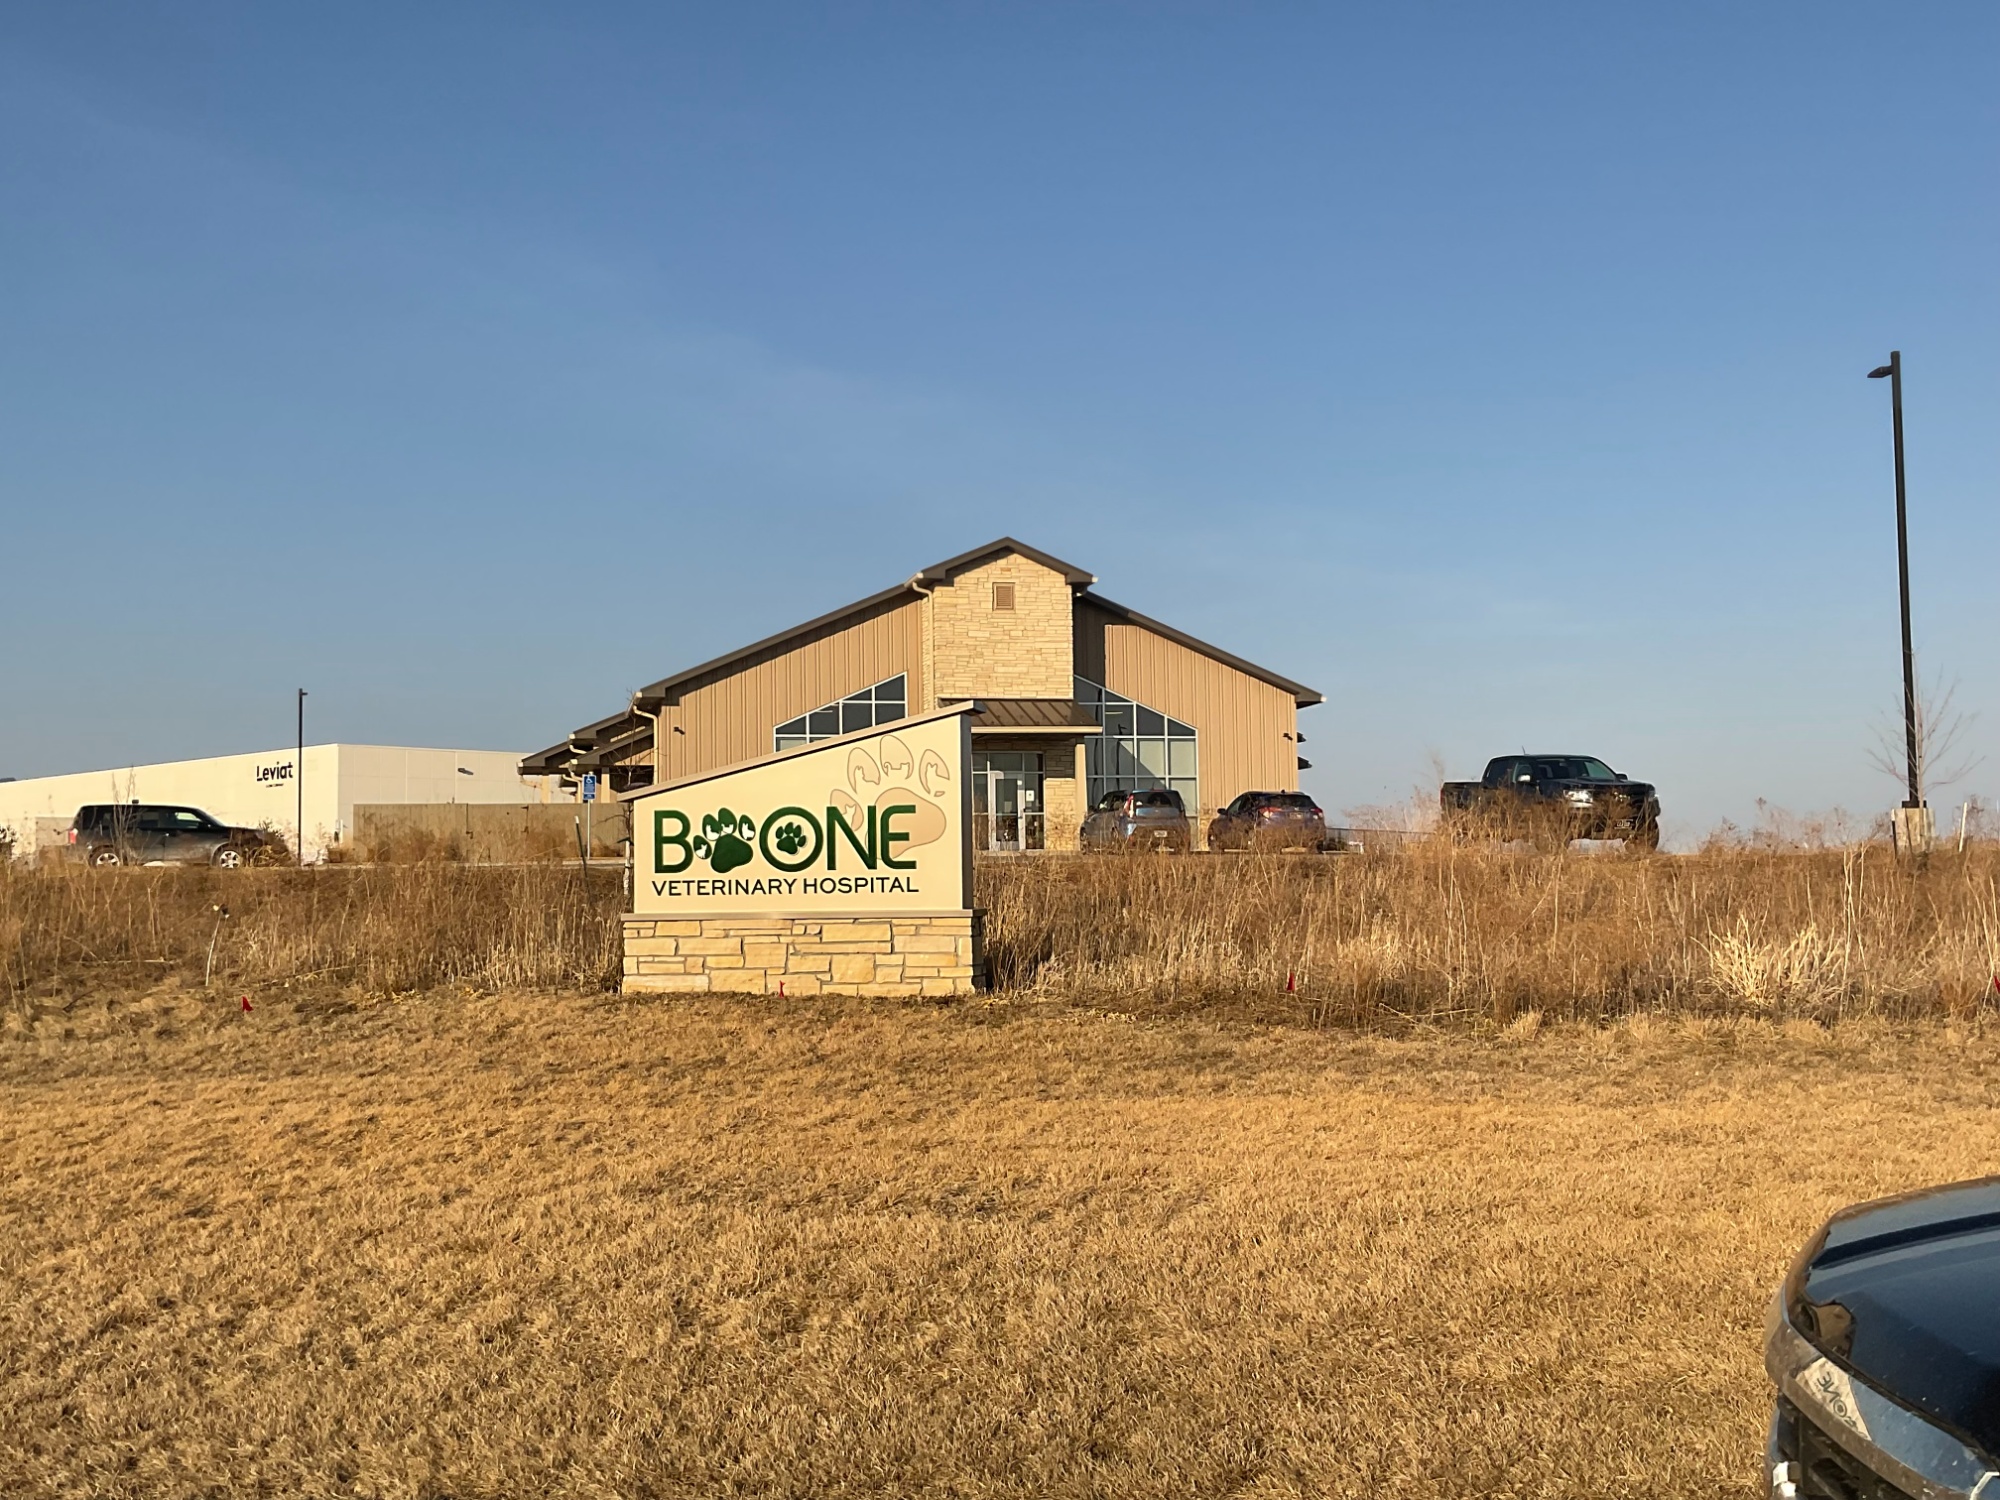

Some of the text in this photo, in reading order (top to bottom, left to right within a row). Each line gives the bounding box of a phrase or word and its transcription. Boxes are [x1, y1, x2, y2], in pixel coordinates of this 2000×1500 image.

[256, 761, 293, 782] Leviat
[651, 877, 919, 896] VETERINARY HOSPITAL
